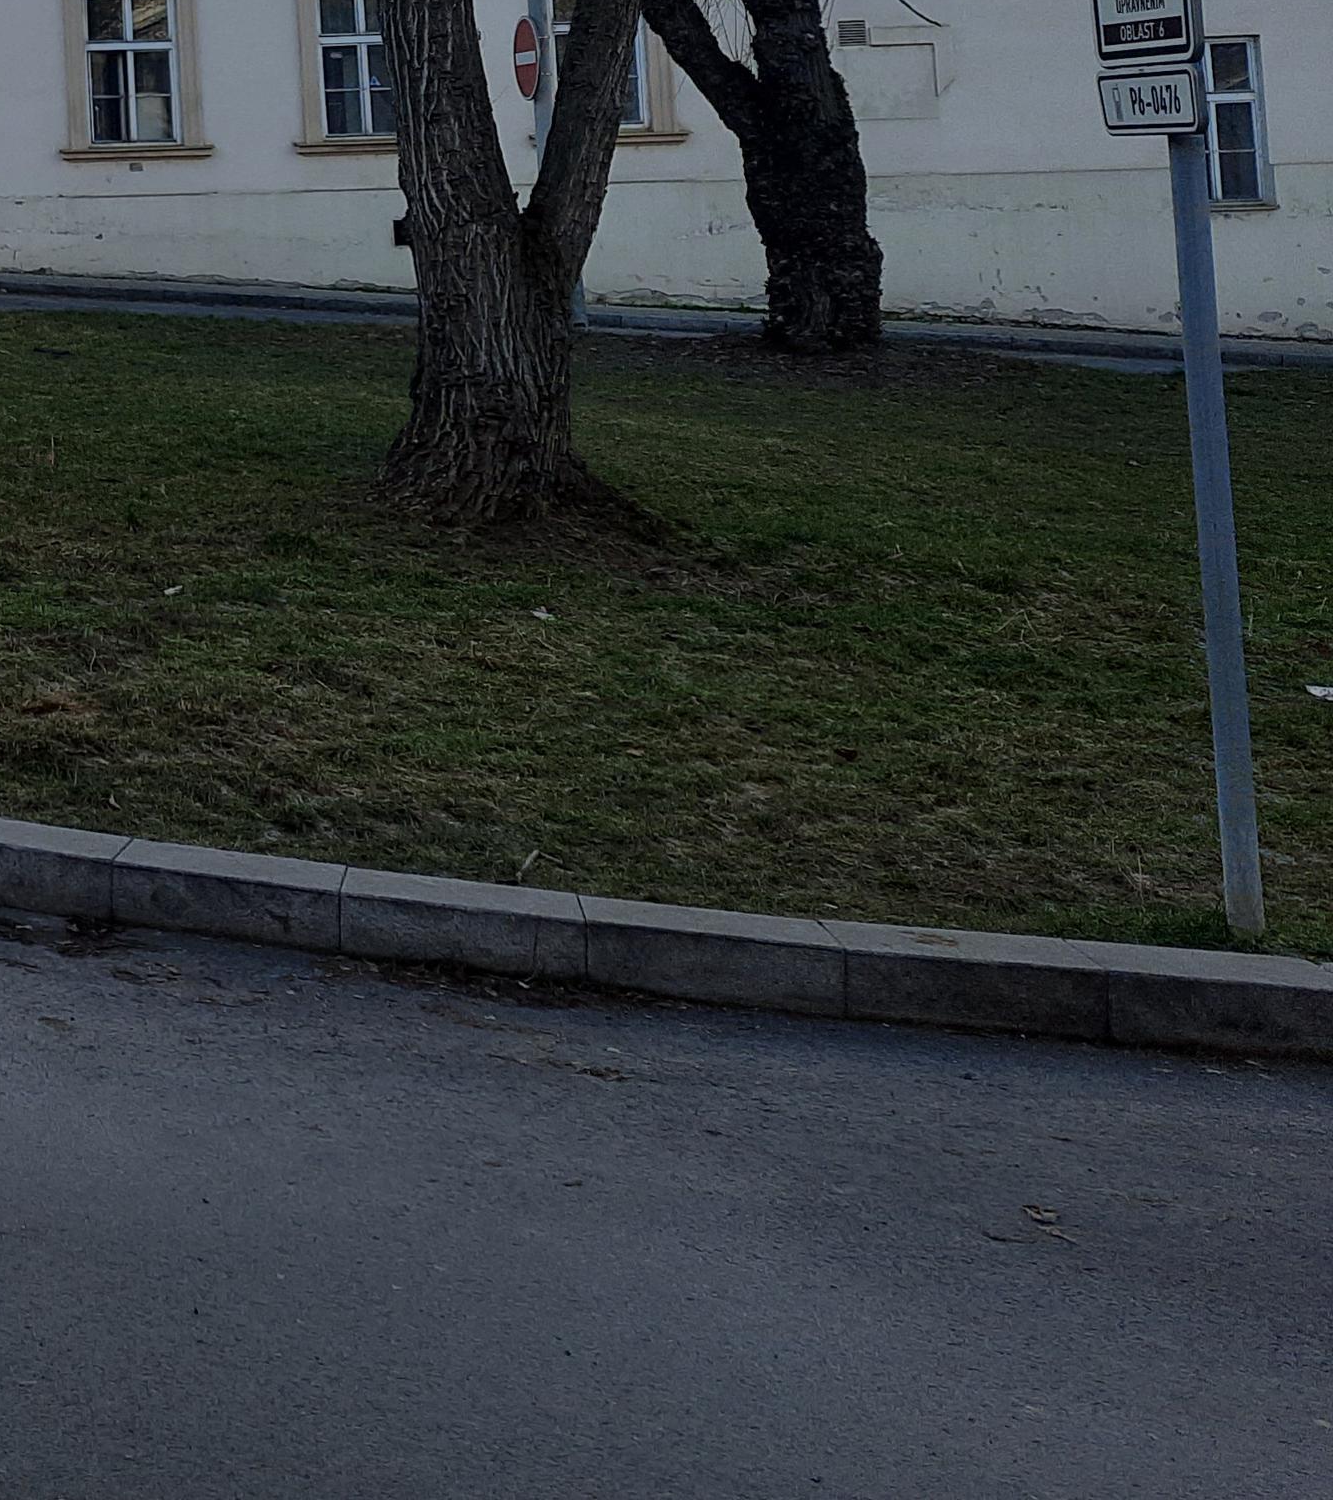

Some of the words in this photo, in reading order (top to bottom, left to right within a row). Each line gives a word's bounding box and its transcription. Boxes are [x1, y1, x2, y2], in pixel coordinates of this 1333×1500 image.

[1120, 22, 1155, 41] OBLAST
[1158, 24, 1165, 38] 6
[1129, 84, 1181, 116] P6-0476
